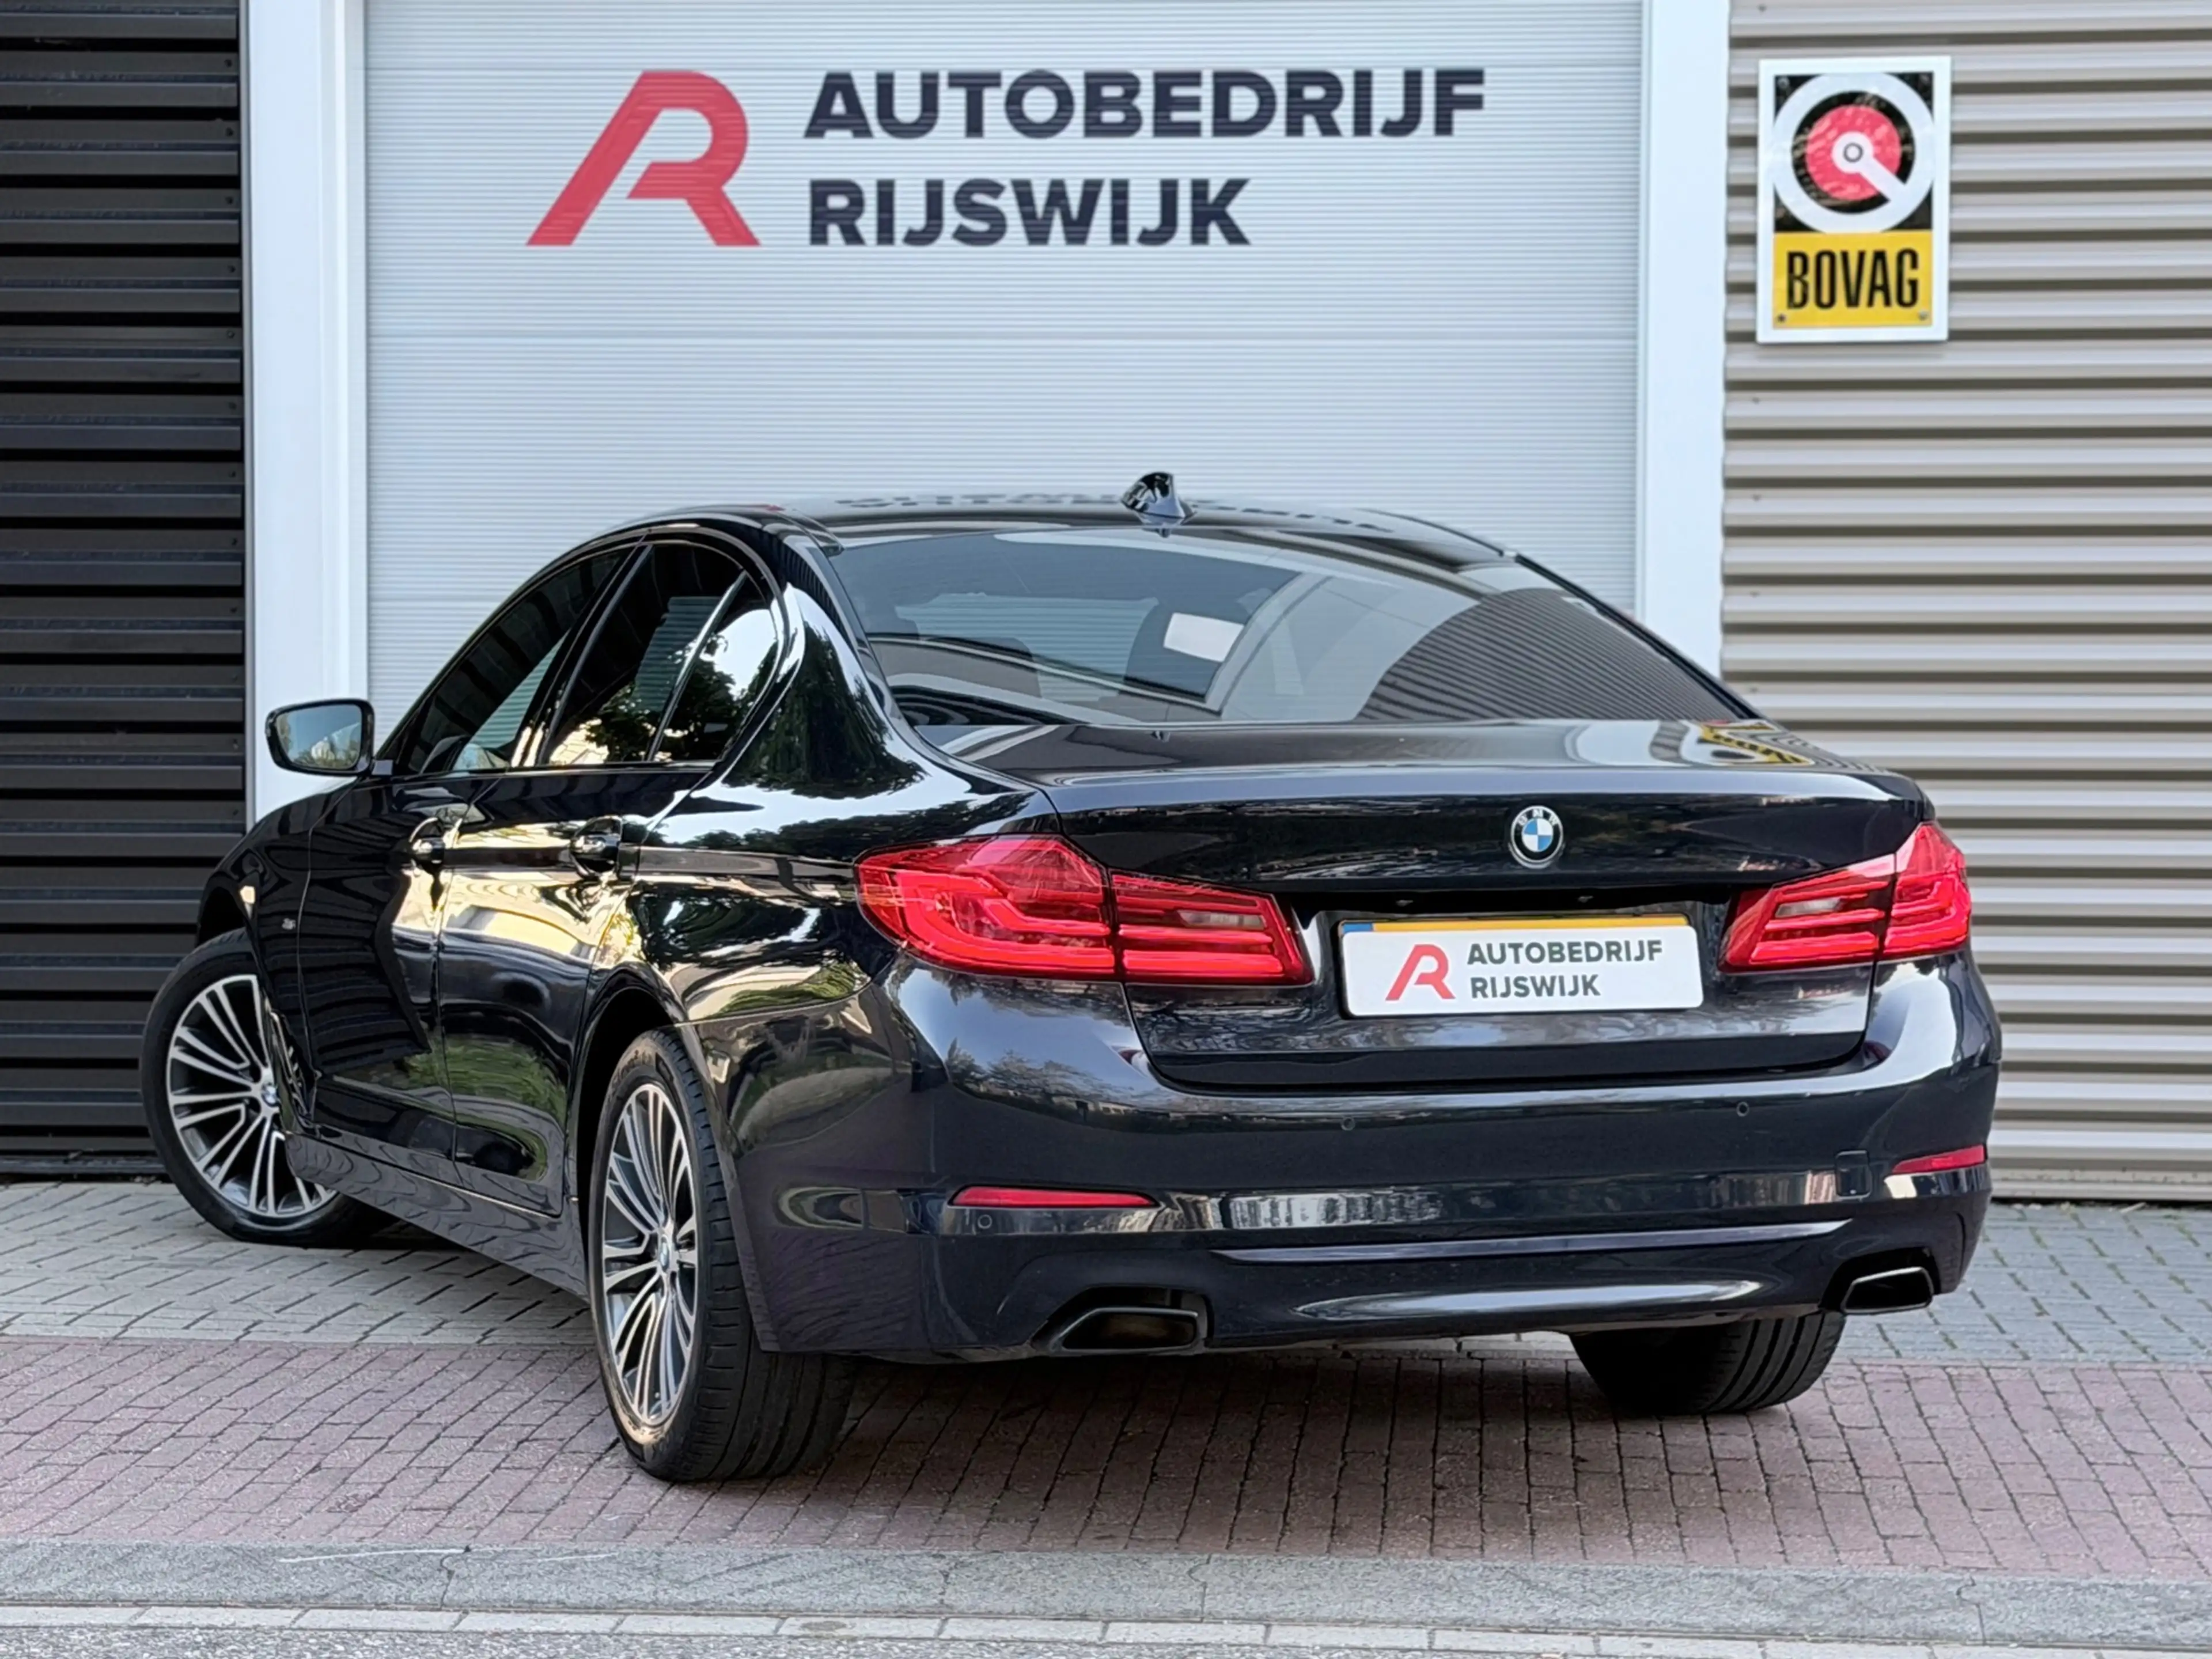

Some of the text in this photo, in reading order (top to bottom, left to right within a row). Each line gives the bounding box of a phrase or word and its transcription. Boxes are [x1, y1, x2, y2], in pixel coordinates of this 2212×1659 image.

[804, 69, 1485, 139] AUTOBEDRIJF
[809, 178, 1250, 247] RIJSWIJK
[1786, 248, 1919, 309] BOVAG
[1467, 940, 1662, 965] AUTOBEDRIJF
[1470, 974, 1600, 998] RIJSWIJK
